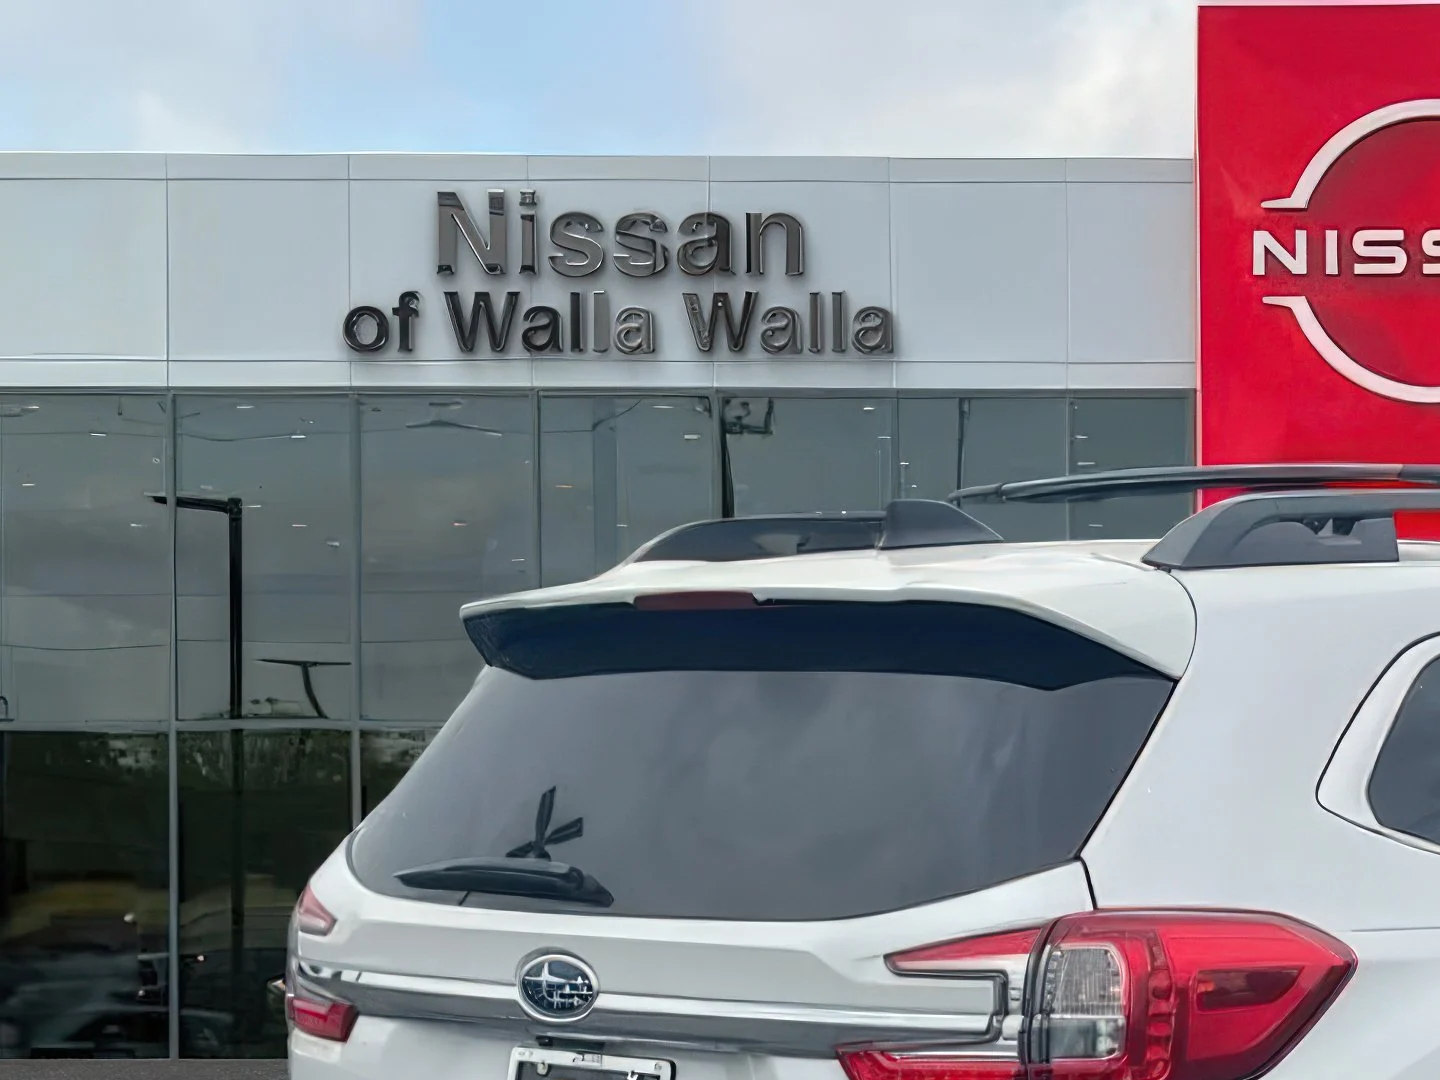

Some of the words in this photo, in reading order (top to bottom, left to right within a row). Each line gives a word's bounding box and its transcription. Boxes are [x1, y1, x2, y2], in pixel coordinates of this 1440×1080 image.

[436, 188, 805, 277] Nissan
[342, 290, 421, 354] of
[444, 290, 657, 355] Walla
[682, 290, 896, 355] Walla
